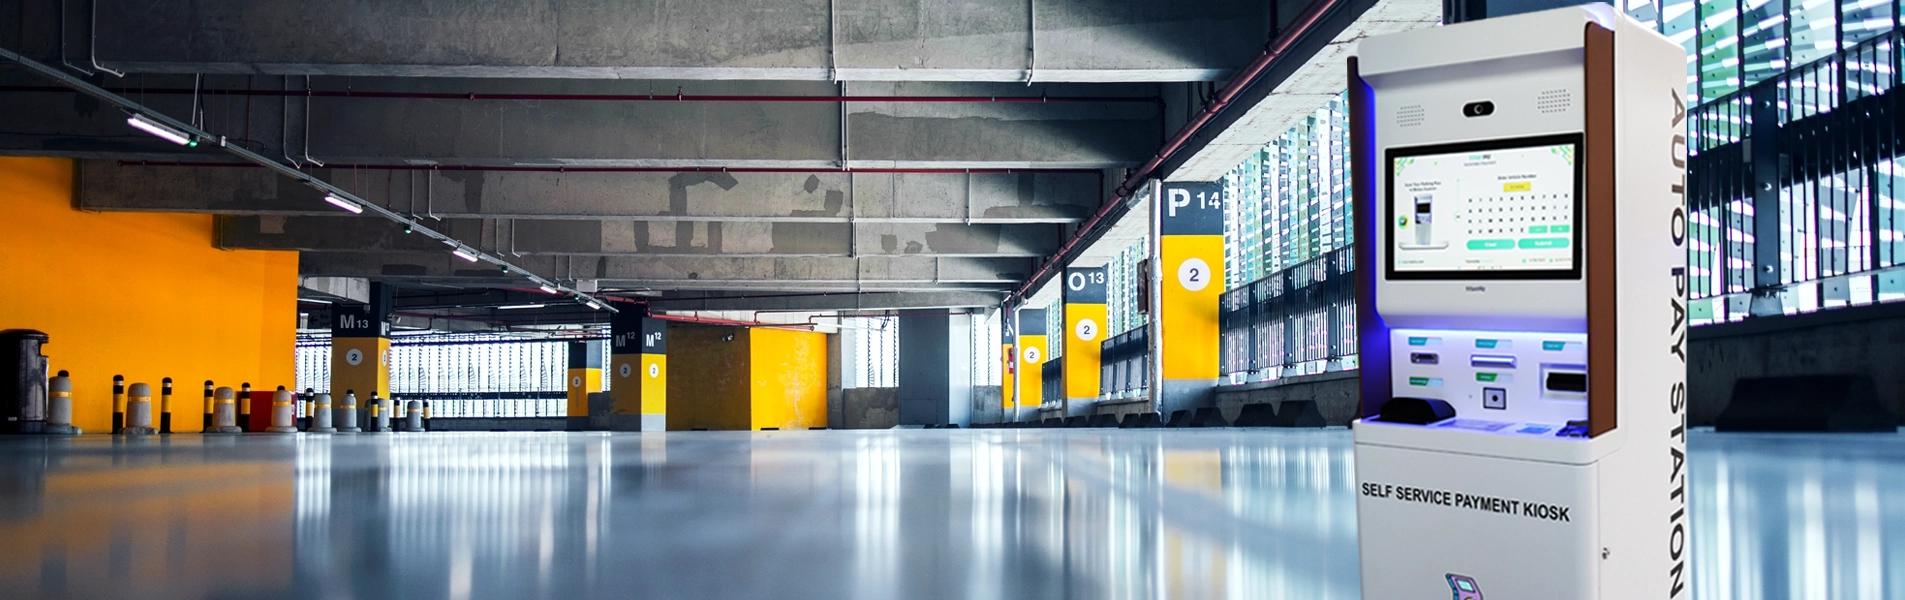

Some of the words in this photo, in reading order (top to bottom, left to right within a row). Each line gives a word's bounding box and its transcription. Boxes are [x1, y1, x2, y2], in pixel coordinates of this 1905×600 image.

[1671, 87, 1686, 247] AUTO
[1168, 188, 1191, 217] P
[1196, 191, 1221, 210] 14
[1068, 272, 1086, 291] O
[1088, 272, 1105, 284] 13
[1189, 267, 1199, 282] 2
[340, 314, 355, 329] M
[356, 319, 369, 329] 13
[1671, 266, 1686, 363] PAY
[1083, 325, 1091, 335] 2
[616, 335, 626, 347] M
[627, 331, 636, 340] 12
[646, 334, 654, 347] M
[654, 331, 662, 341] 12
[351, 353, 358, 361] 2
[1029, 351, 1035, 359] 2
[1670, 381, 1686, 600] STATION
[1362, 482, 1393, 498] SELF
[1395, 486, 1451, 506] SERVICE
[1454, 493, 1519, 515] PAYMENT
[1523, 502, 1570, 522] KIOSK
